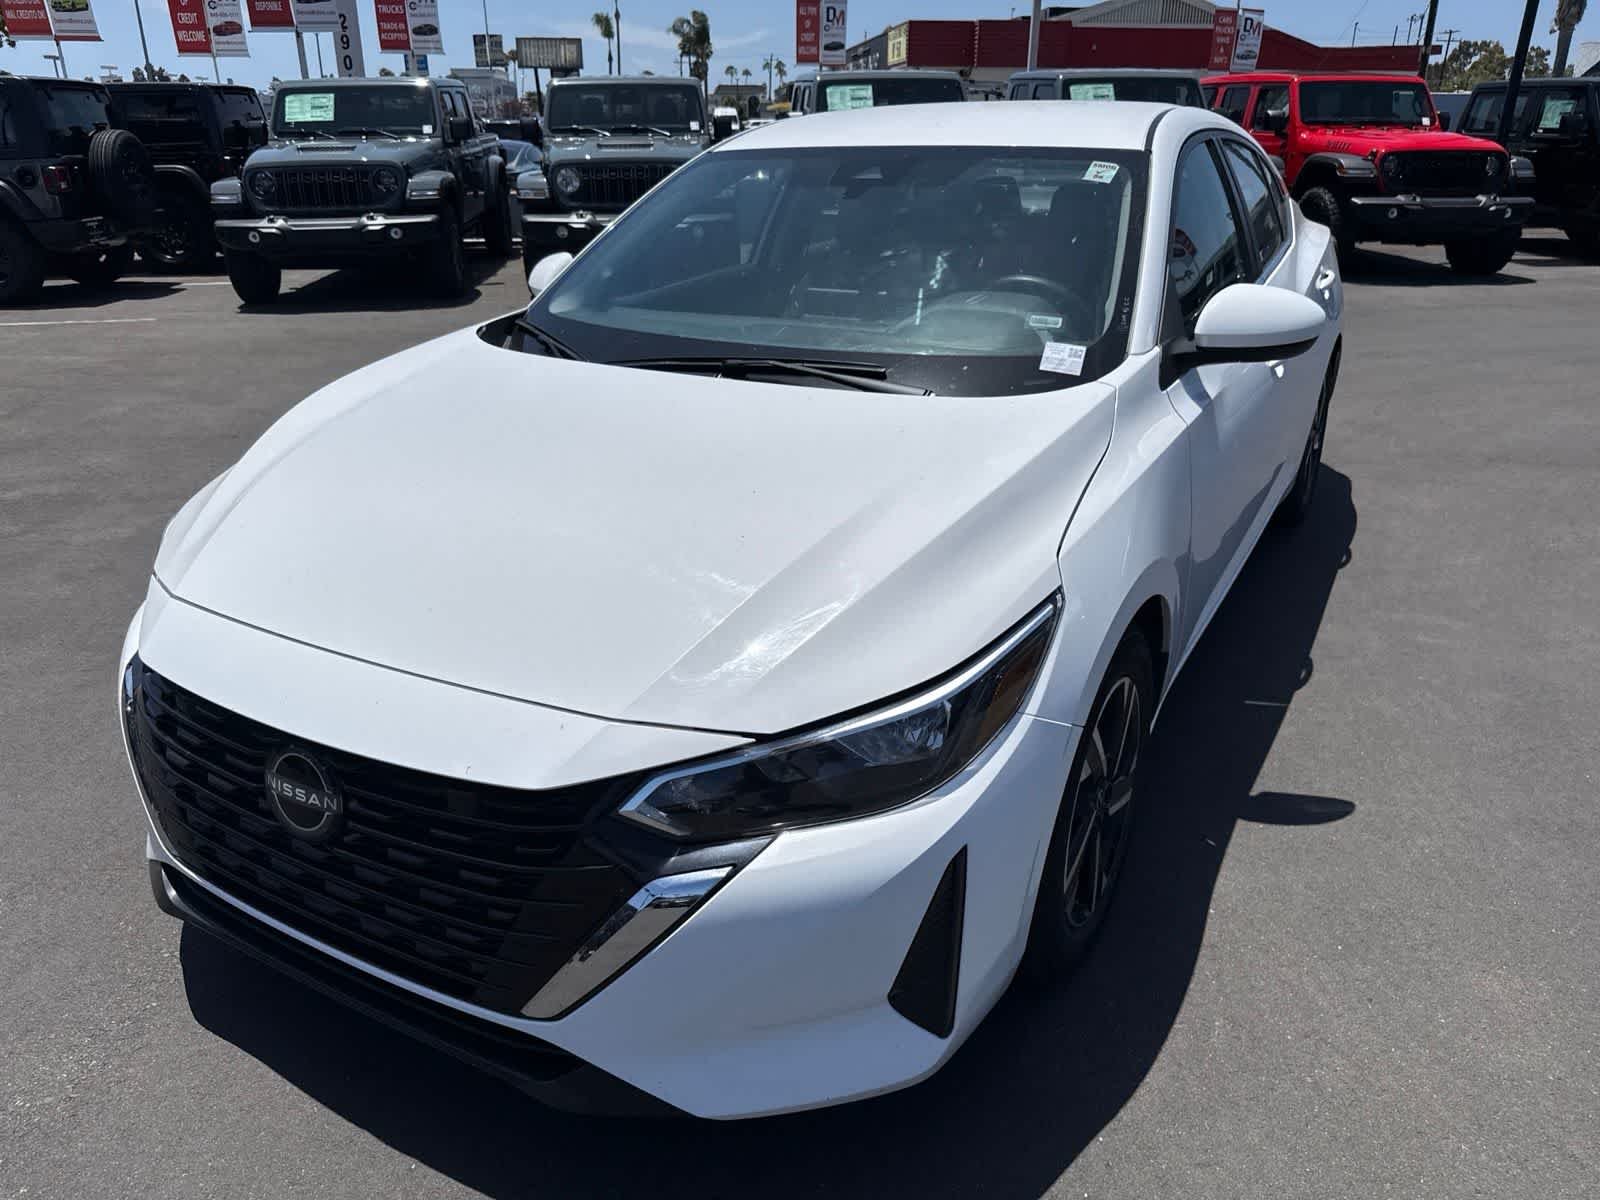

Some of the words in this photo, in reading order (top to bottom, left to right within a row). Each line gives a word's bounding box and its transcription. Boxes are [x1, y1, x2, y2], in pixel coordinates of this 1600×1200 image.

[377, 4, 405, 15] TRUCKS
[177, 12, 199, 25] CREDIT
[176, 29, 207, 43] WELCOME
[338, 13, 354, 77] 290
[266, 773, 337, 812] NISSAN
